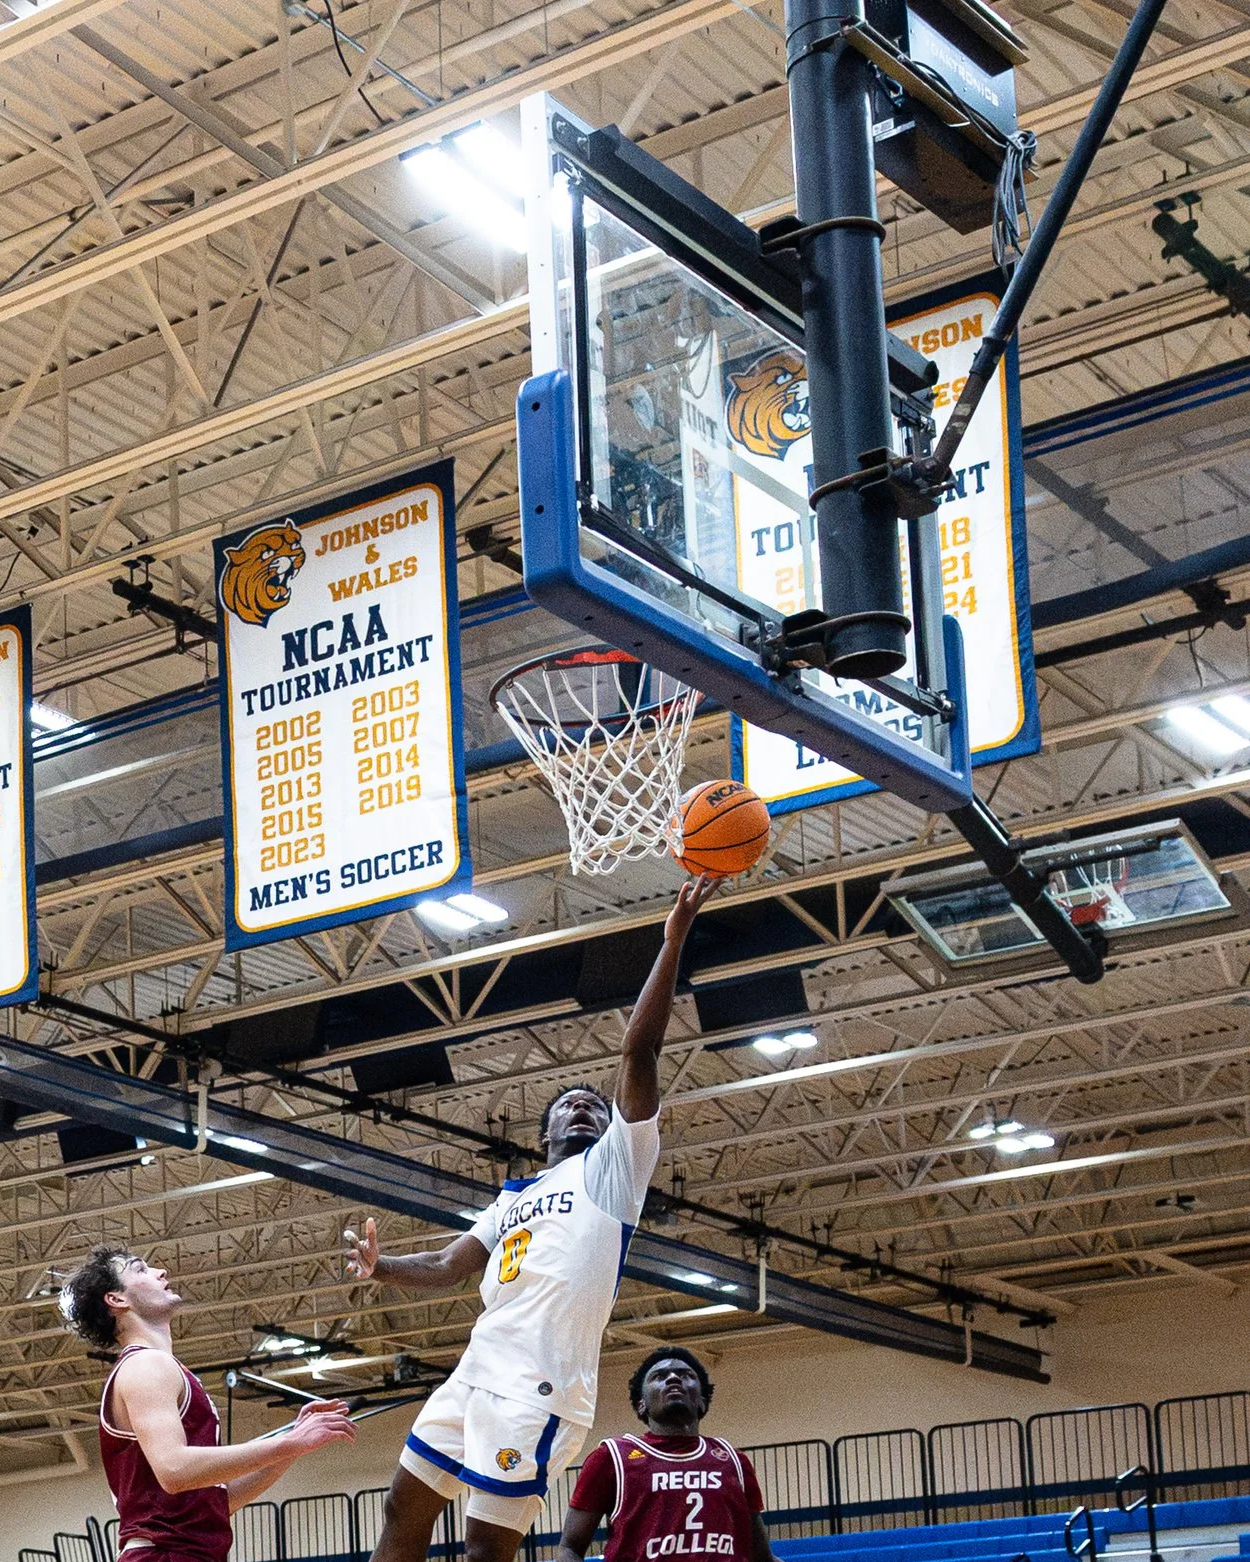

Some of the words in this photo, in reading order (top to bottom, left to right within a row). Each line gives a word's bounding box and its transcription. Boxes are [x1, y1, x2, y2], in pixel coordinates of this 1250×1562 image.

[315, 500, 429, 557] JOHNSON
[365, 543, 380, 565] &
[327, 556, 419, 602] WALES
[281, 603, 388, 672] NCAA
[241, 634, 433, 716] TOURNAMENT
[256, 710, 321, 751] 2002
[352, 680, 420, 723] 2003
[257, 740, 322, 781] 2005
[353, 711, 420, 754] 2007
[261, 771, 321, 811] 2013
[358, 743, 420, 784] 2014
[261, 802, 323, 841] 2015
[359, 774, 421, 816] 2019
[249, 869, 331, 912] MEN'S
[340, 840, 443, 889] SOCCER
[260, 833, 326, 872] 2023
[498, 1227, 533, 1285] 0
[652, 1470, 723, 1493] REGIS
[685, 1491, 704, 1530] 2
